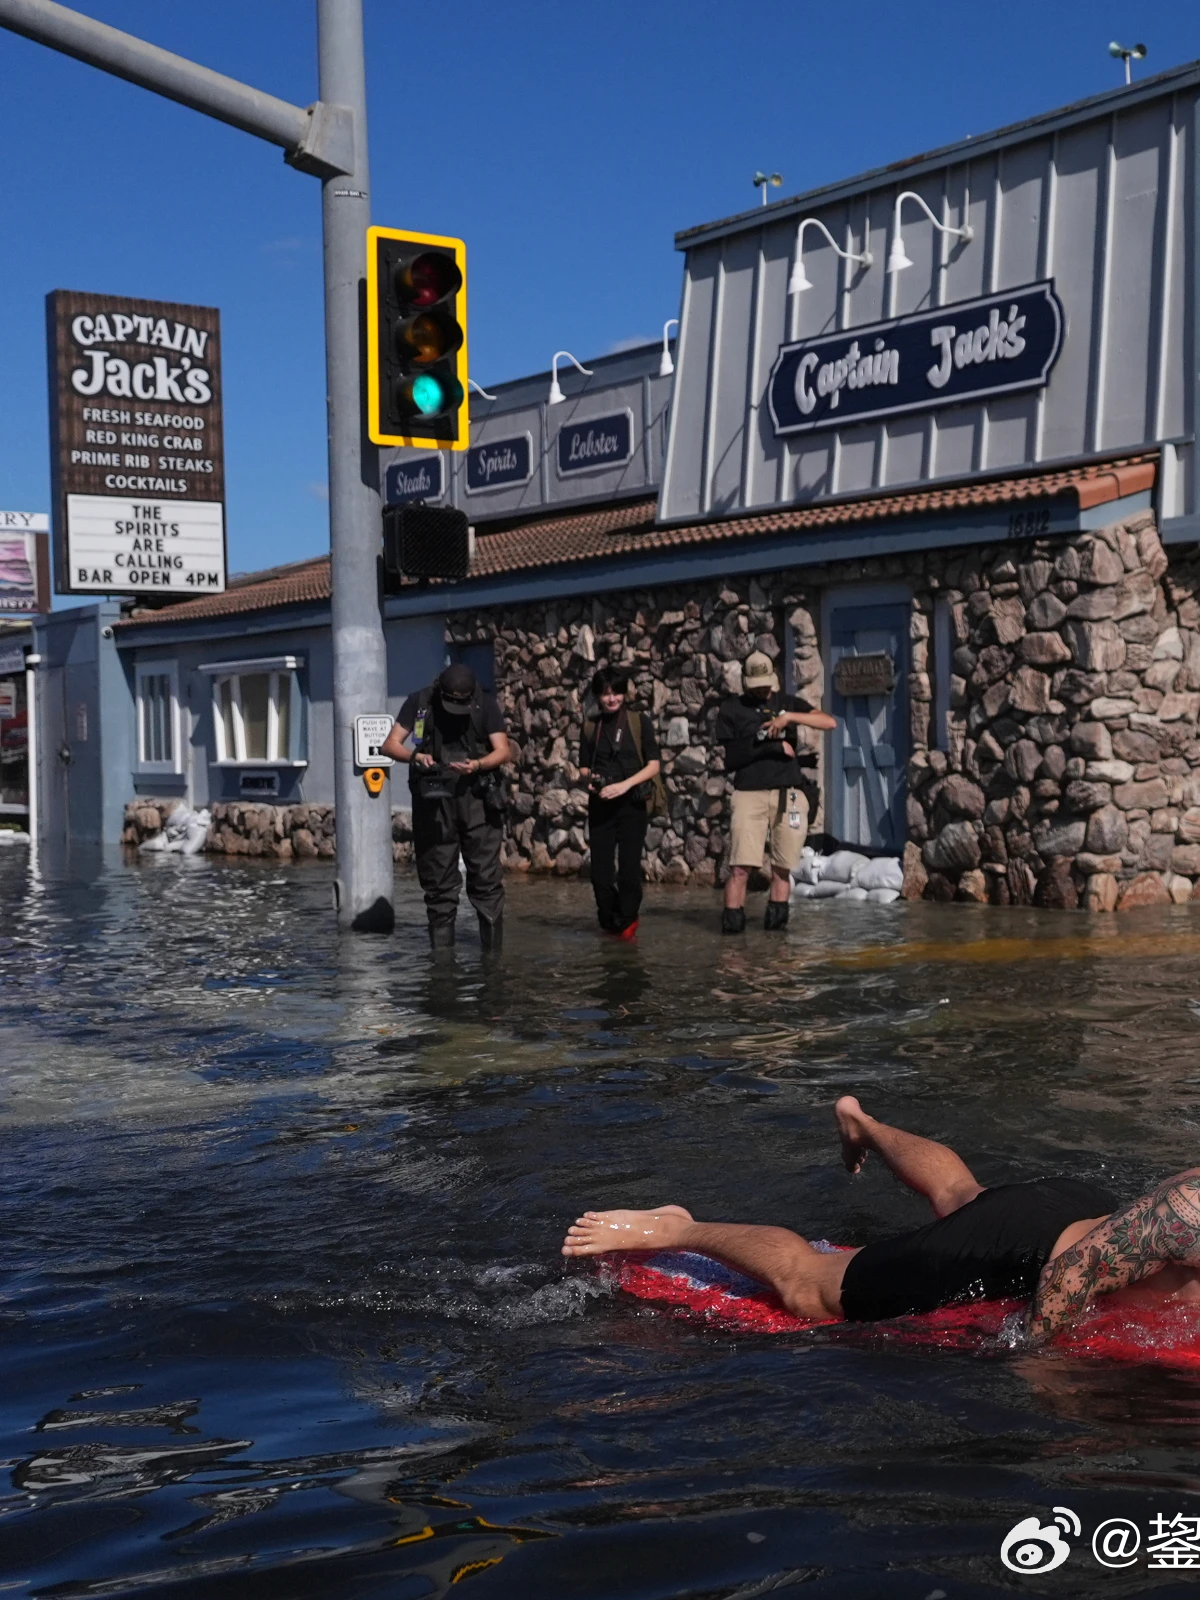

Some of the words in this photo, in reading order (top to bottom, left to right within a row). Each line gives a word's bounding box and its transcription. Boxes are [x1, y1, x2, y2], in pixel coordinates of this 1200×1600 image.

[72, 313, 208, 359] CAPTAIN
[794, 338, 900, 415] Captain
[926, 304, 1027, 388] Jack's
[71, 350, 212, 404] Jack's
[82, 407, 131, 424] FRESH
[134, 411, 205, 430] SEAFOOD
[85, 429, 117, 445] RED
[121, 432, 159, 448] KING
[163, 435, 203, 451] CRAB
[569, 430, 619, 461] Lobster
[71, 450, 121, 467] PRIME
[124, 453, 150, 469] RIB
[158, 456, 214, 473] STEAKS
[477, 448, 518, 481] Spirits
[105, 474, 188, 493] COCKTAILS
[395, 467, 431, 496] Steaks
[0, 512, 34, 527] RY
[132, 505, 162, 520] THE
[115, 521, 180, 537] SPIRITS
[133, 538, 164, 552] ARE
[115, 553, 183, 569] CALLING
[78, 568, 113, 583] BAR
[129, 570, 171, 585] OPEN
[186, 572, 219, 586] 4PM
